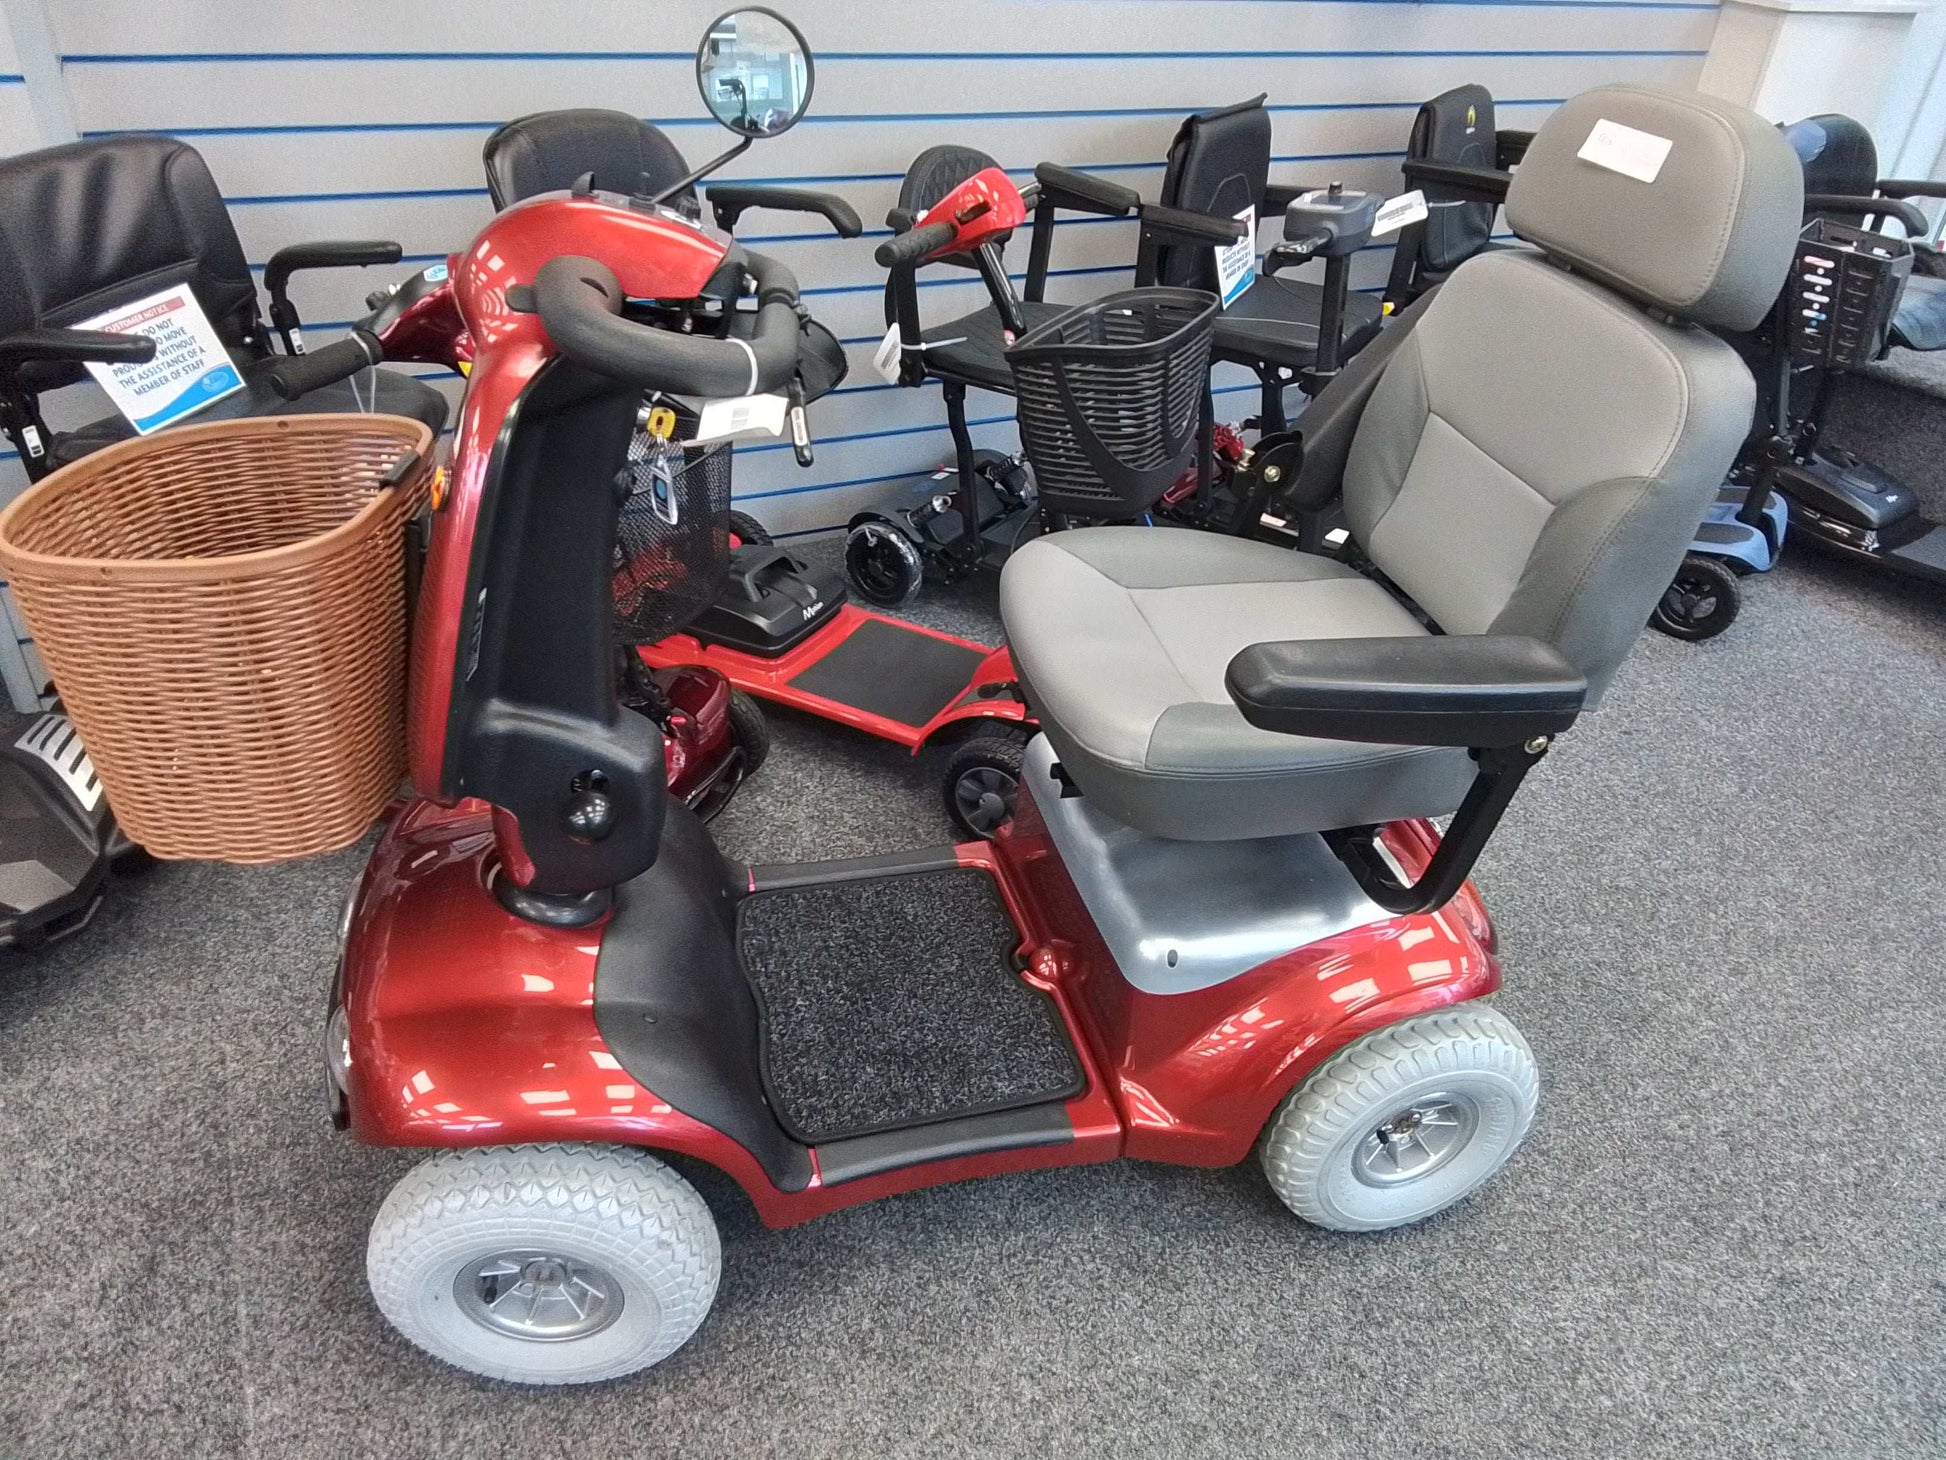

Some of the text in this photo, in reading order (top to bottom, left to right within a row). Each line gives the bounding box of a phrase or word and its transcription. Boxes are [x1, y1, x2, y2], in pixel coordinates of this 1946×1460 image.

[104, 304, 168, 332] CUSTOMER NOTICE
[142, 326, 156, 335] DO
[155, 318, 174, 331] NOT
[158, 335, 197, 357] WITHOUT
[163, 326, 187, 341] MOVE
[119, 345, 206, 388] THE ASSISTANCE OF A
[133, 358, 205, 396] MEMBER OF STAFF
